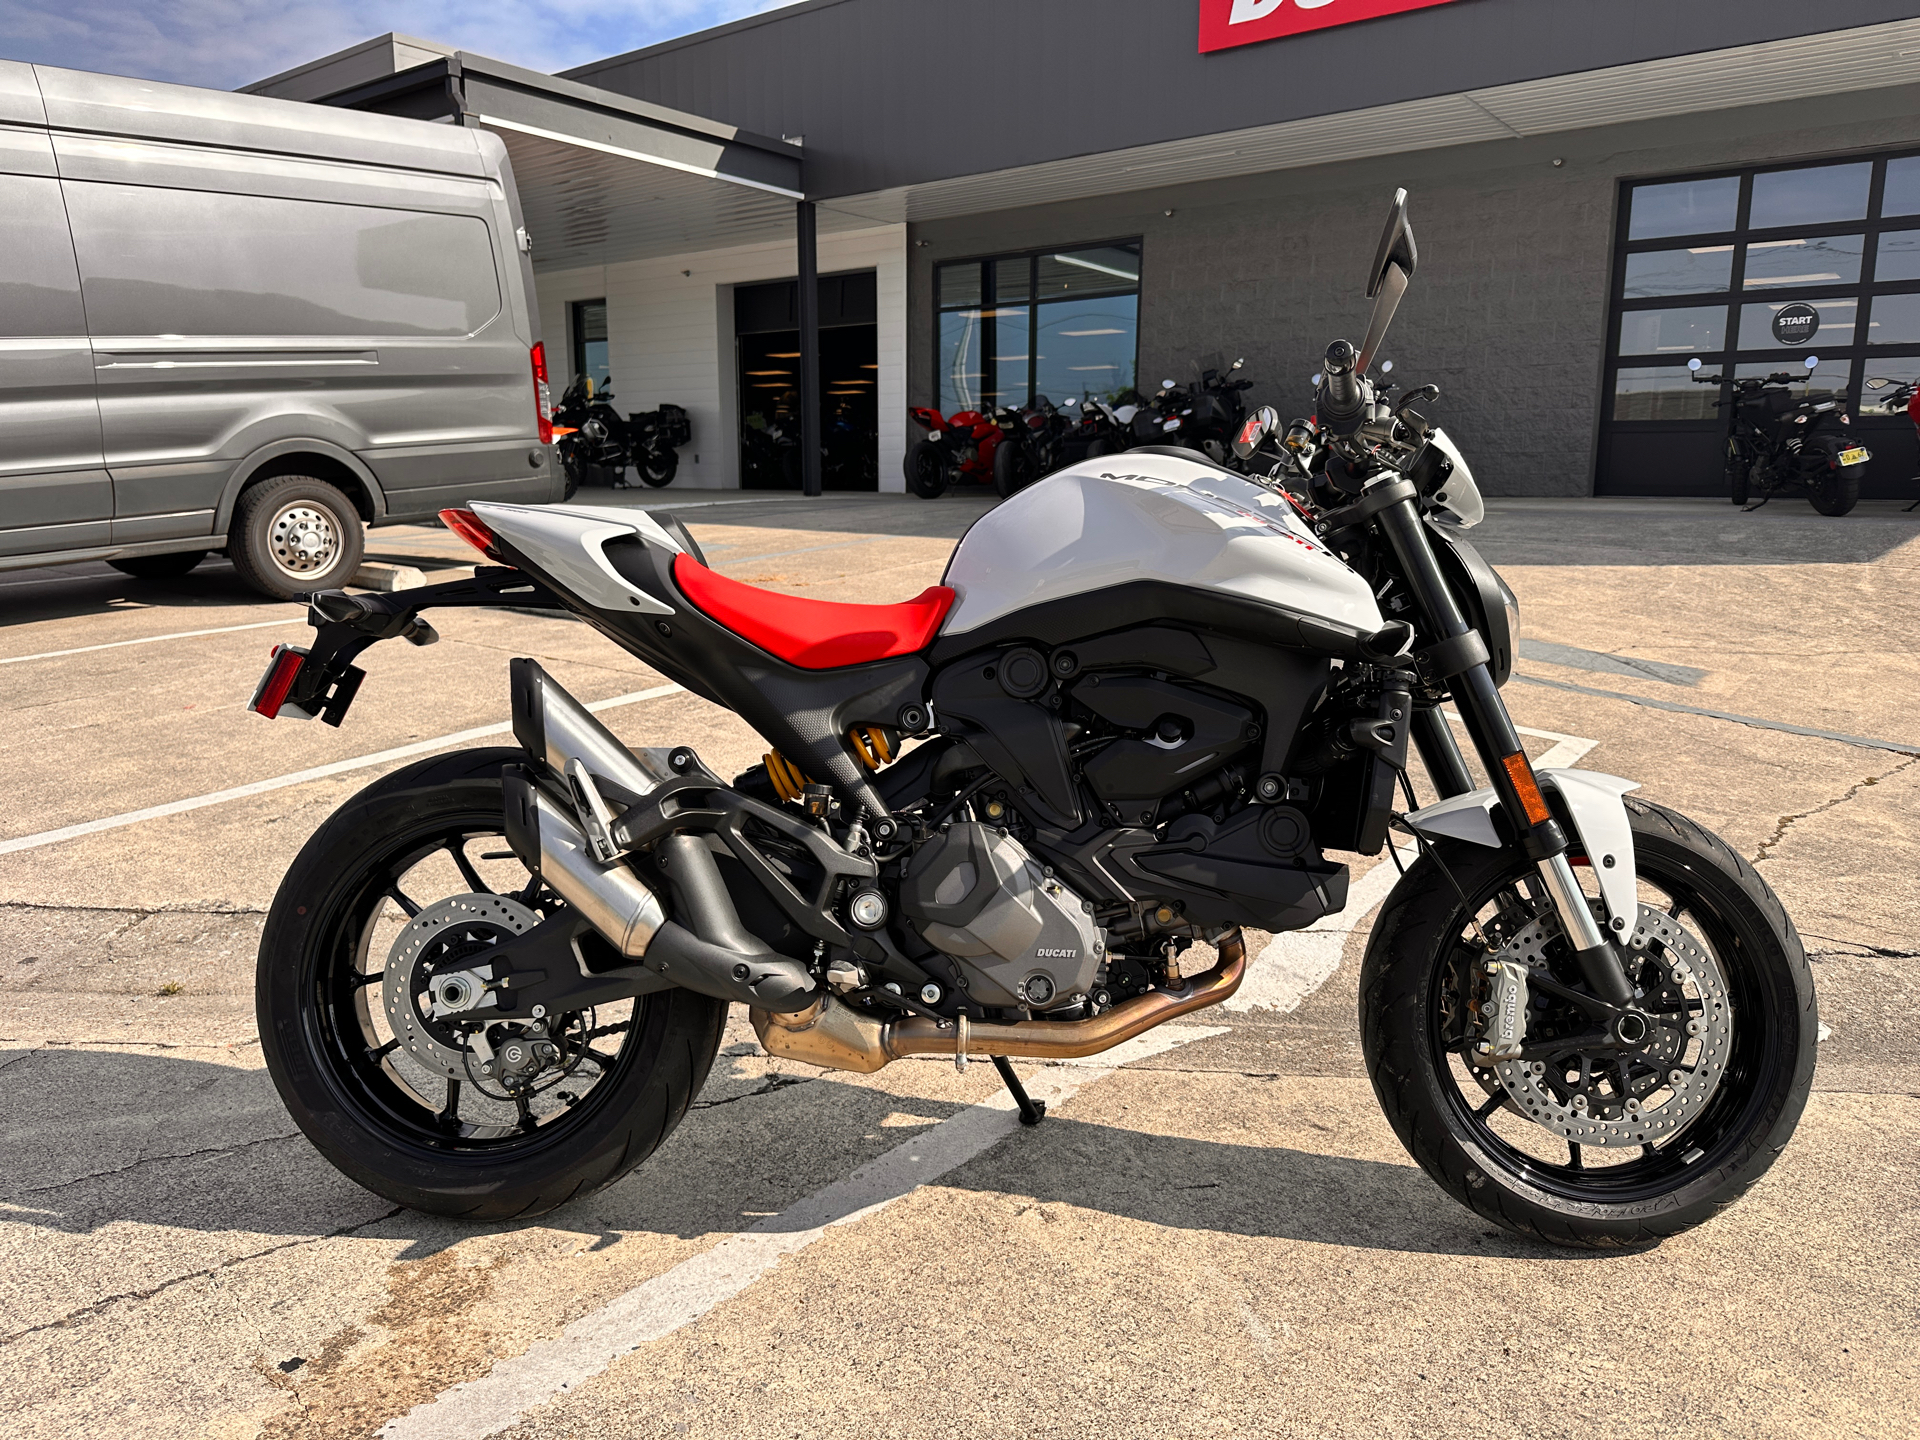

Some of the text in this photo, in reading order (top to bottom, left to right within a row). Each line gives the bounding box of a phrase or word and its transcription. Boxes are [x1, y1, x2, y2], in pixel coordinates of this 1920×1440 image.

[1779, 316, 1813, 326] START
[1781, 325, 1810, 334] HERE
[1037, 948, 1077, 958] DUCATI
[1501, 984, 1518, 1039] brembo
